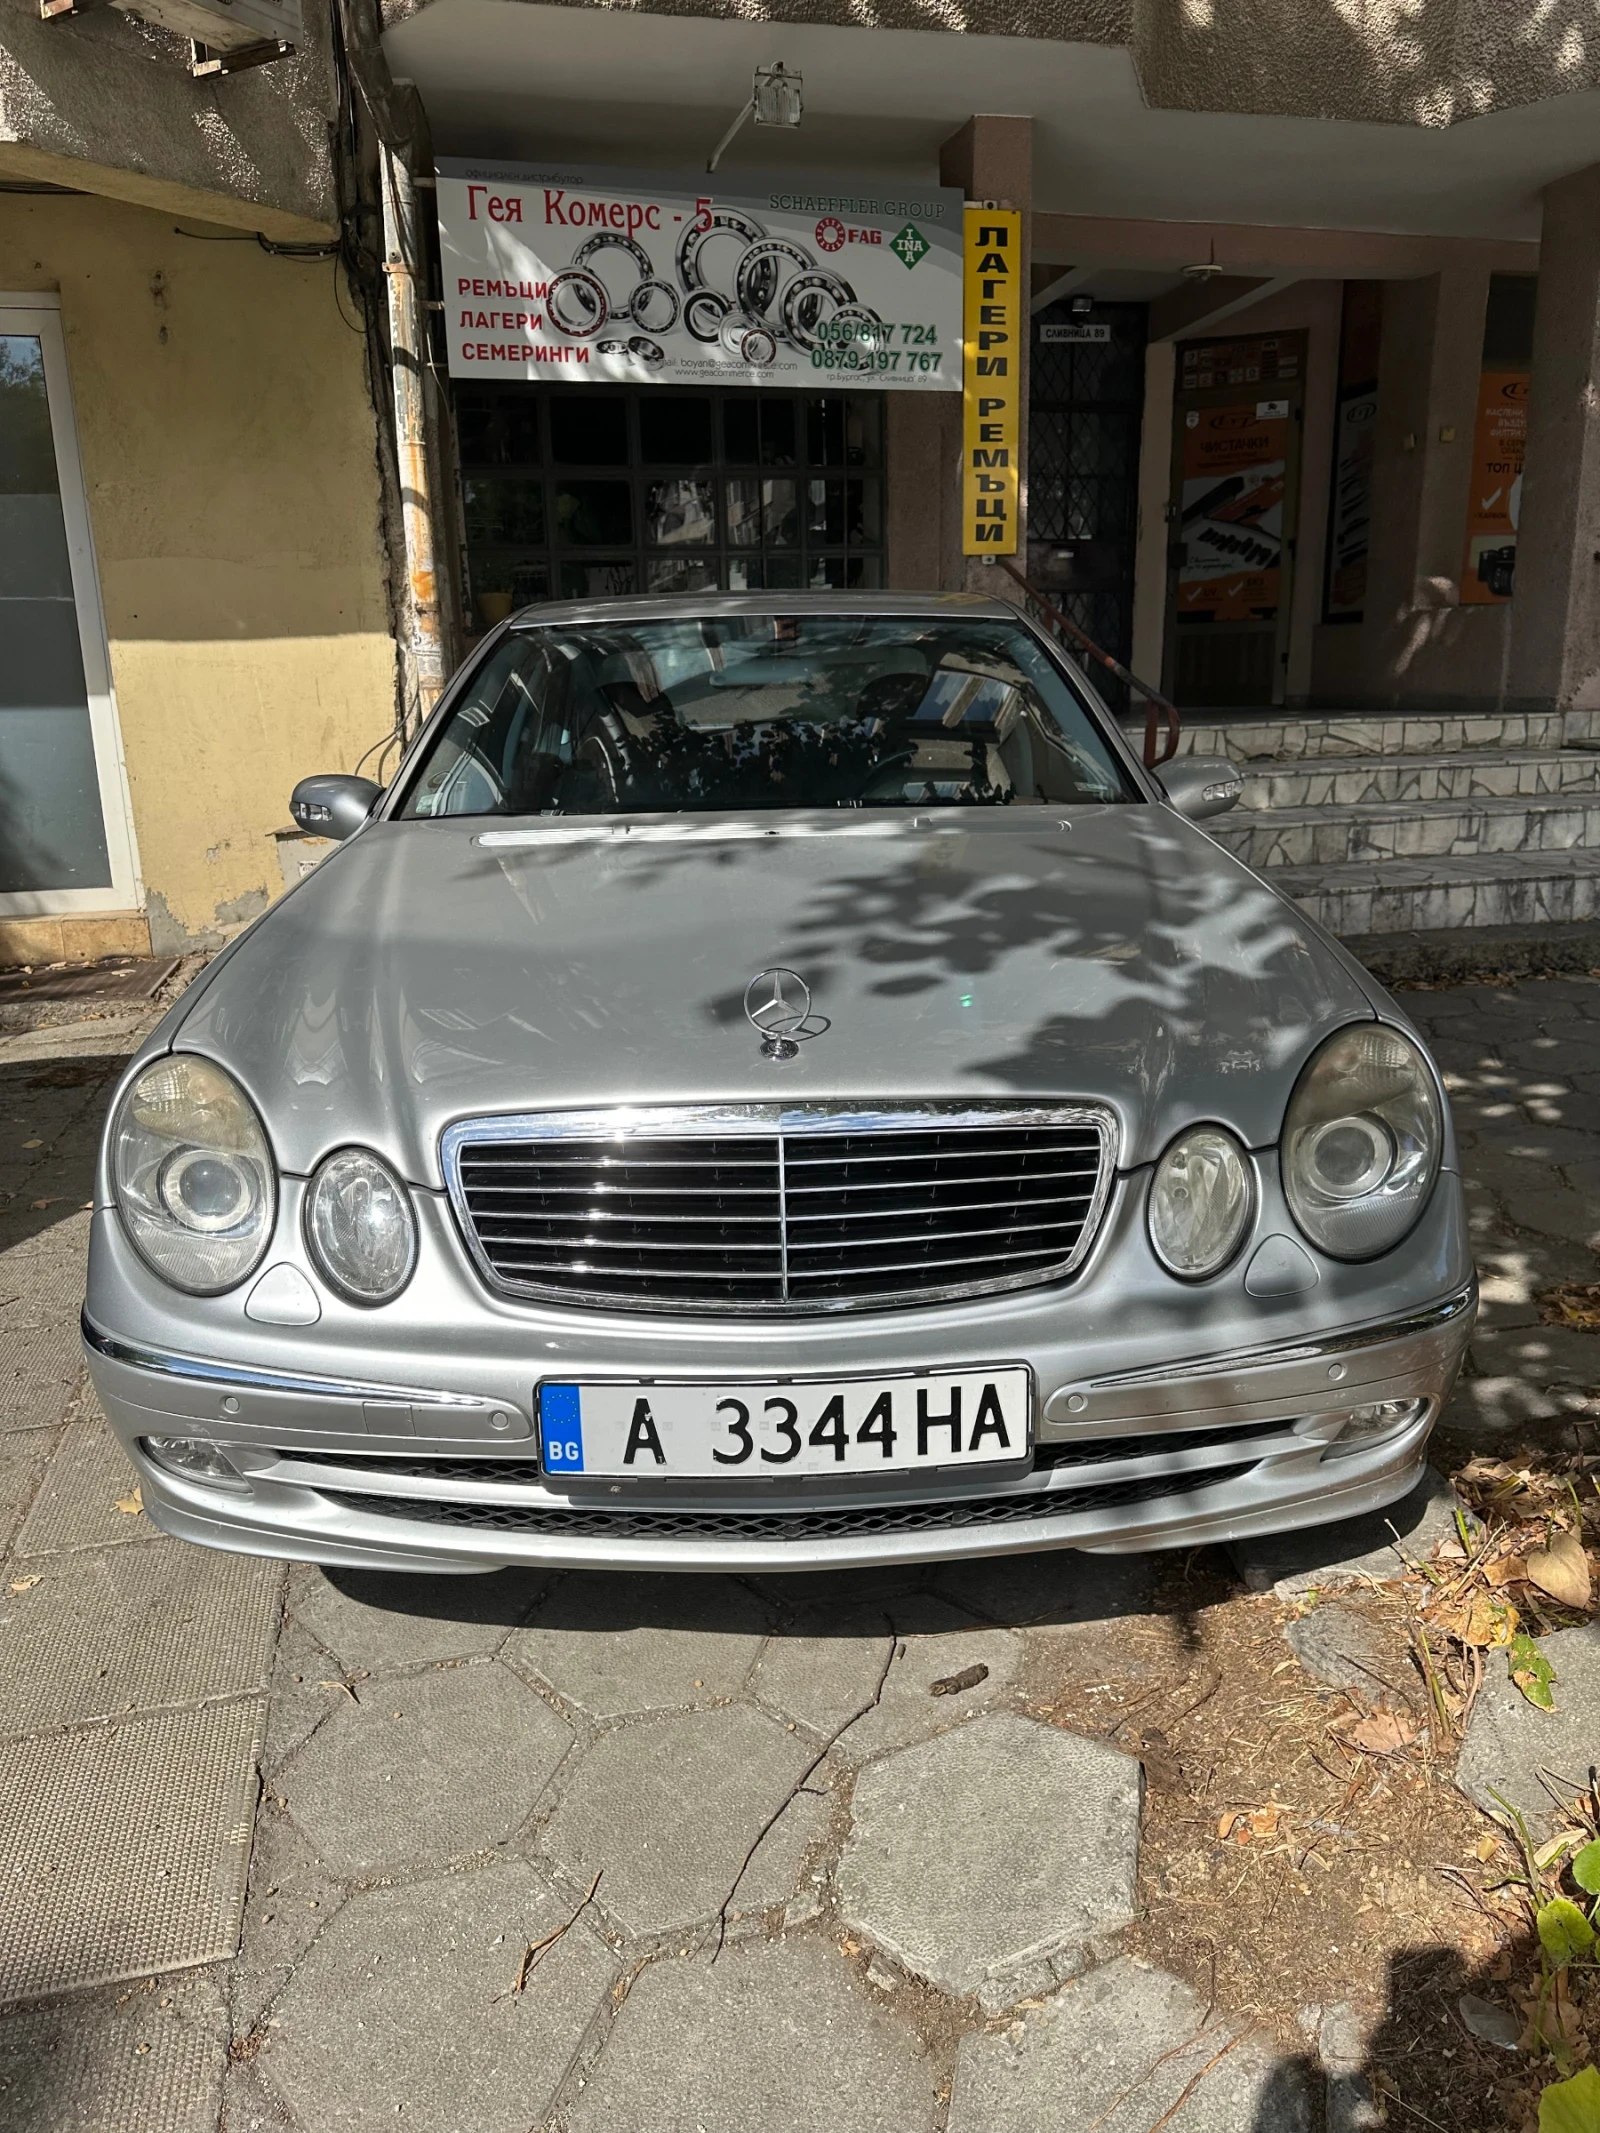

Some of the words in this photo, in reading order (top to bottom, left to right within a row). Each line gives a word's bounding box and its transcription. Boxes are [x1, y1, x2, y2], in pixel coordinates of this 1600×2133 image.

[467, 185, 523, 222] Гея
[543, 189, 660, 239] Комерс
[695, 197, 713, 232] 5
[770, 194, 879, 214] SCHAEFFLER
[884, 201, 945, 218] GROUP
[848, 229, 882, 244] FAG
[458, 278, 548, 300] РЕМЪЦИ
[974, 226, 1008, 376] ЛАГЕРИ
[460, 311, 543, 330] ЛАГЕРИ
[817, 323, 894, 344] 056/817
[901, 325, 937, 345] 724
[1045, 328, 1091, 338] СЛИВНИЦА
[1094, 328, 1105, 338] 89
[462, 342, 590, 363] СЕМЕРИНГИ
[811, 350, 860, 370] 0879
[867, 351, 902, 371] 197
[906, 352, 943, 372] 767
[674, 368, 774, 378] www.geacommerce.com
[1200, 436, 1269, 453] ЧИСТАЧКИ
[972, 398, 1008, 541] РЕМЪЦИ
[1486, 462, 1509, 474] ТОП
[623, 1397, 668, 1465] A
[712, 1390, 898, 1465] 3344
[915, 1383, 1012, 1456] HA
[548, 1440, 579, 1461] BG
